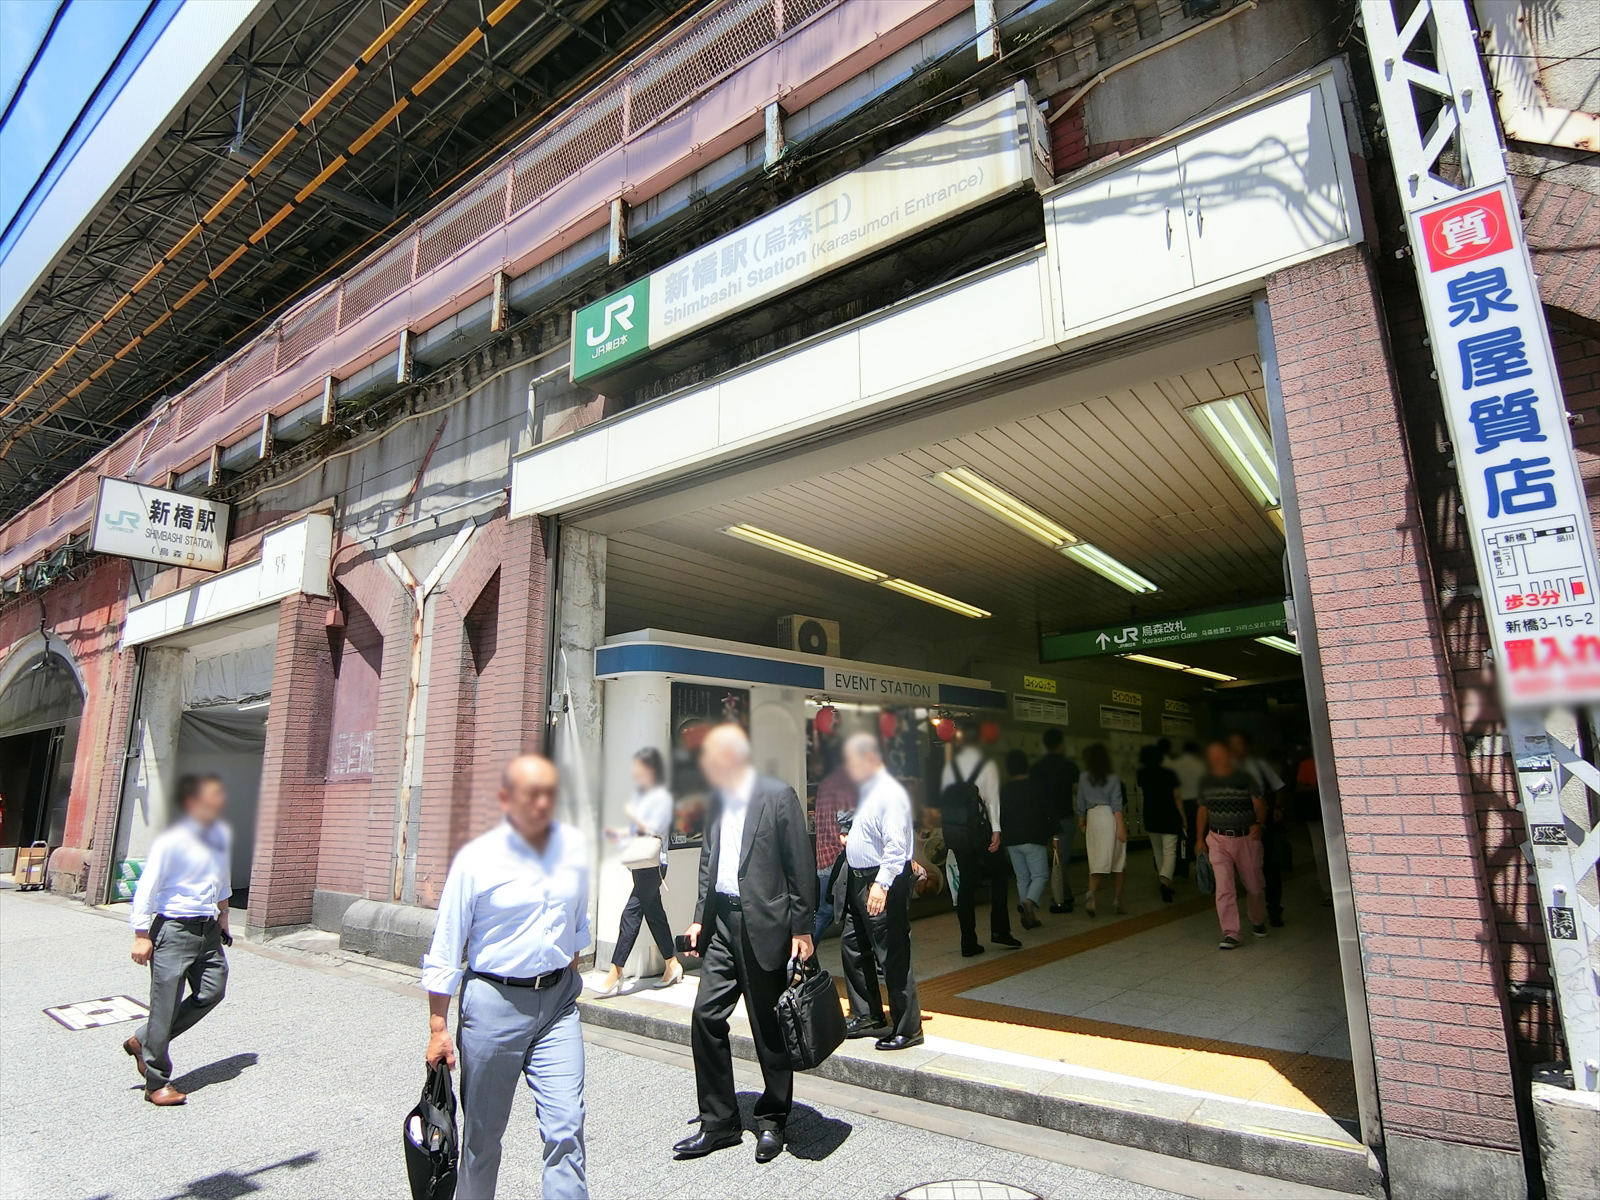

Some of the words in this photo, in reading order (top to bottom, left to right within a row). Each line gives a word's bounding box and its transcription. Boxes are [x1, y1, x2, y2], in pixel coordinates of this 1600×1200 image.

[1441, 208, 1492, 255] 質
[663, 277, 742, 326] Shimbashi
[747, 250, 807, 288] Station
[812, 207, 899, 260] (Karasumori
[904, 167, 984, 217] Entrance)
[586, 294, 635, 347] JR
[591, 334, 628, 359] JR東日本
[1447, 266, 1557, 519] 泉屋質店
[104, 510, 141, 530] JR
[149, 498, 217, 534] 新橋駅
[145, 527, 183, 544] SHIMBASHI
[184, 535, 213, 550] STATION
[1504, 532, 1527, 544] 新橋
[1556, 533, 1575, 542] 品川
[1492, 550, 1505, 576] 新橋ビル
[1502, 548, 1511, 567] ニュー
[1504, 590, 1560, 611] 歩3分
[1505, 612, 1594, 634] 新橋3-15-2
[1113, 626, 1139, 644] JR
[1142, 633, 1180, 645] Karasumori
[1181, 631, 1198, 640] Gate
[835, 673, 877, 691] EVENT
[880, 679, 931, 699] STATION
[1025, 677, 1056, 691] コインロッカー
